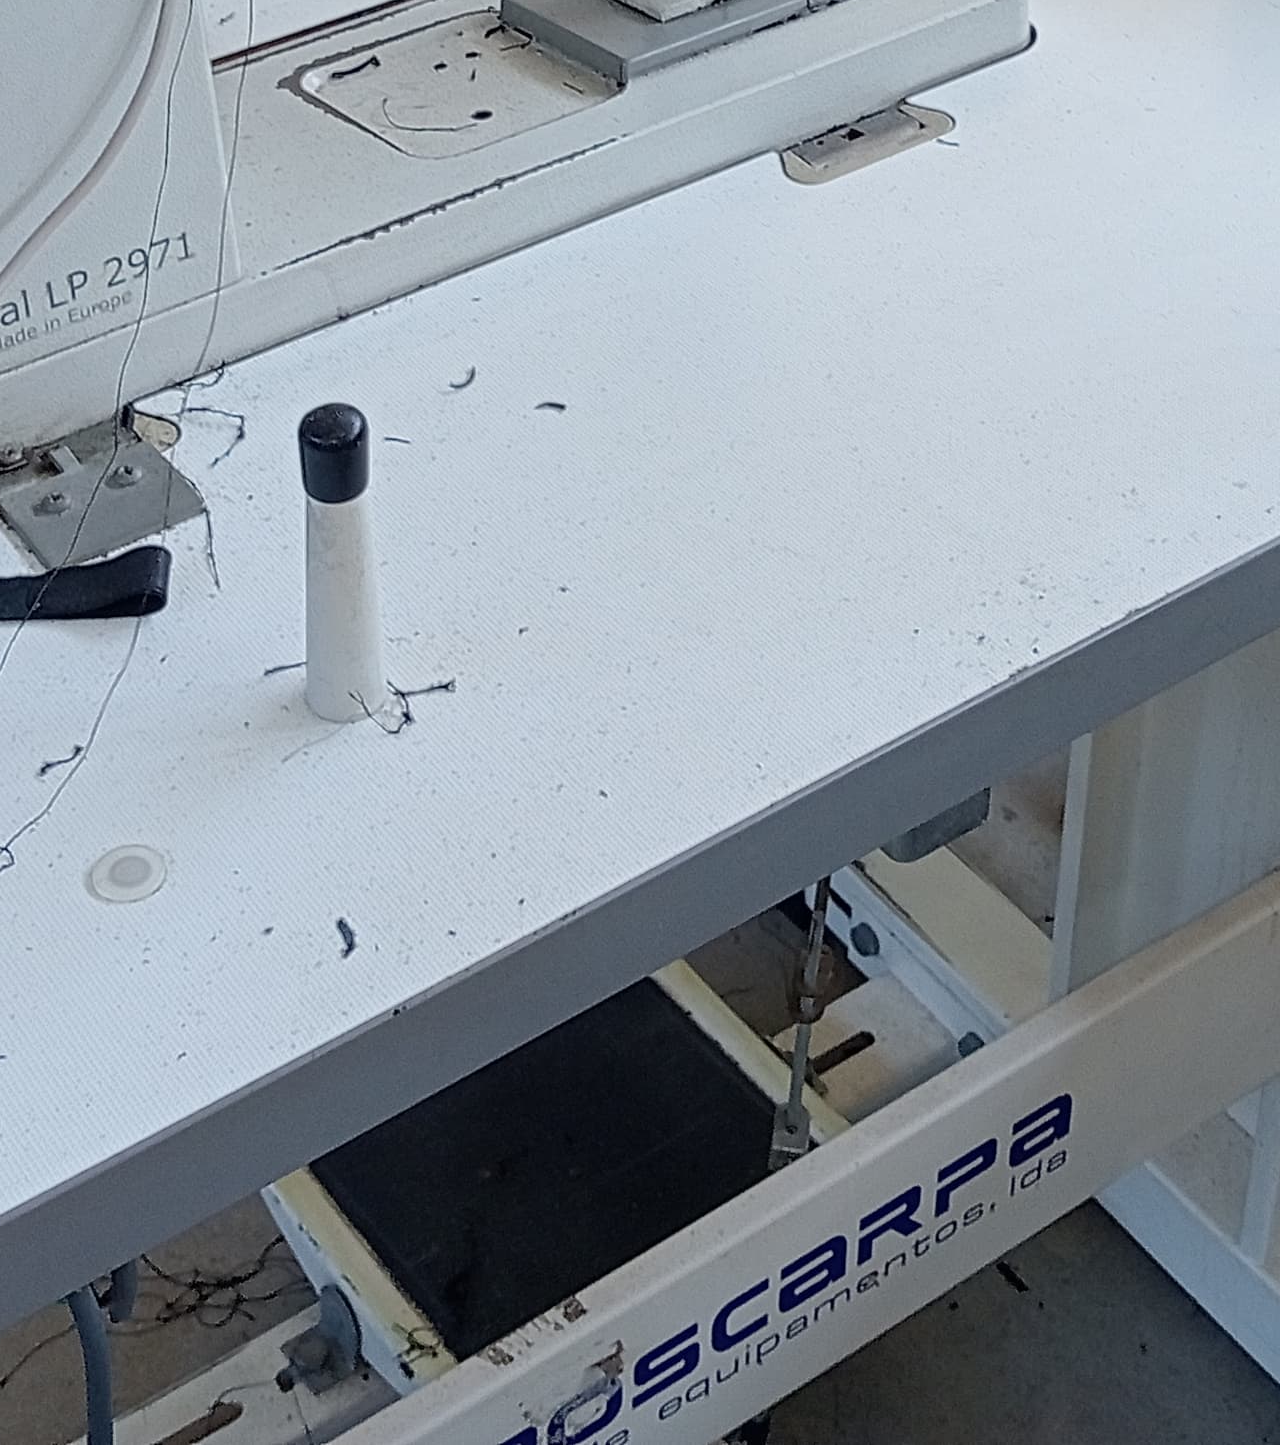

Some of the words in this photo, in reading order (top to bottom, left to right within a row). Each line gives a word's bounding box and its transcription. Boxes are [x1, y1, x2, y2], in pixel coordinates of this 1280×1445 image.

[45, 269, 89, 309] LP
[104, 231, 196, 289] 2971
[44, 317, 62, 335] in
[68, 289, 134, 324] Europe
[1009, 1147, 1070, 1198] lda
